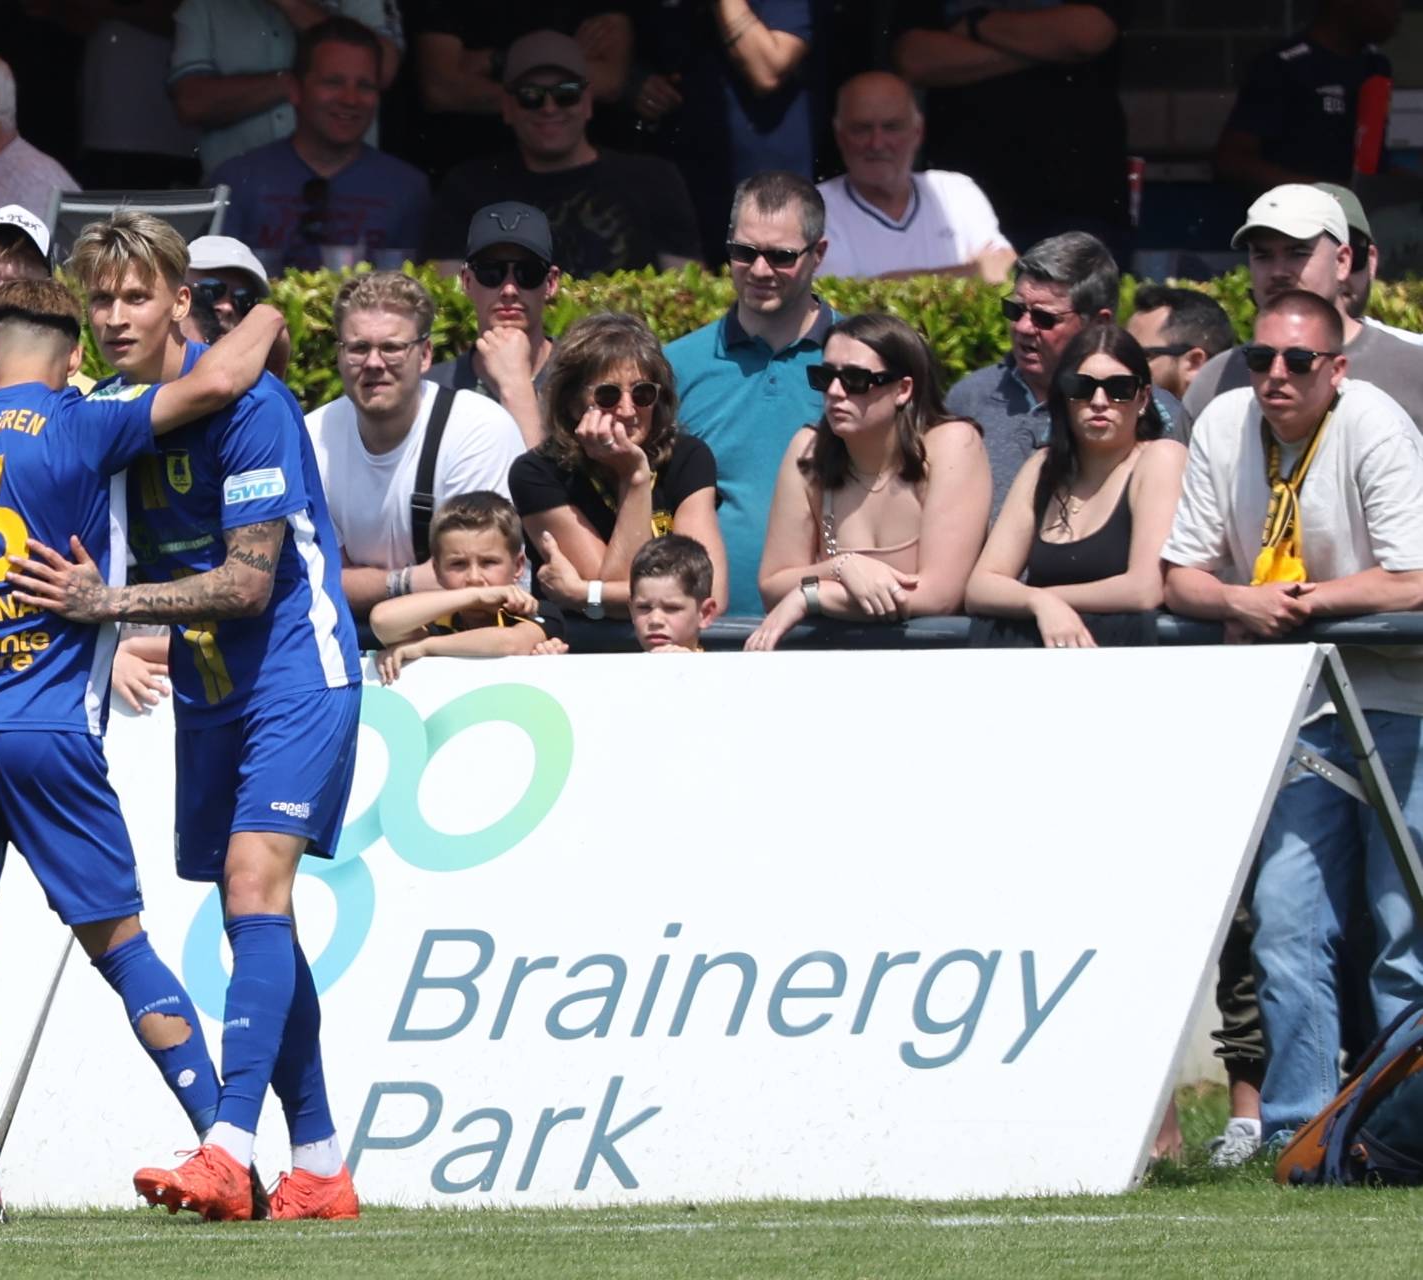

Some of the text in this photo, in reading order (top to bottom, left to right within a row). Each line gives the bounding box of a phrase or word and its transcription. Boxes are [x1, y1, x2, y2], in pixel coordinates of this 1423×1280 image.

[228, 480, 284, 502] SWD
[387, 922, 1098, 1069] Brainergy
[344, 1075, 663, 1193] Park
